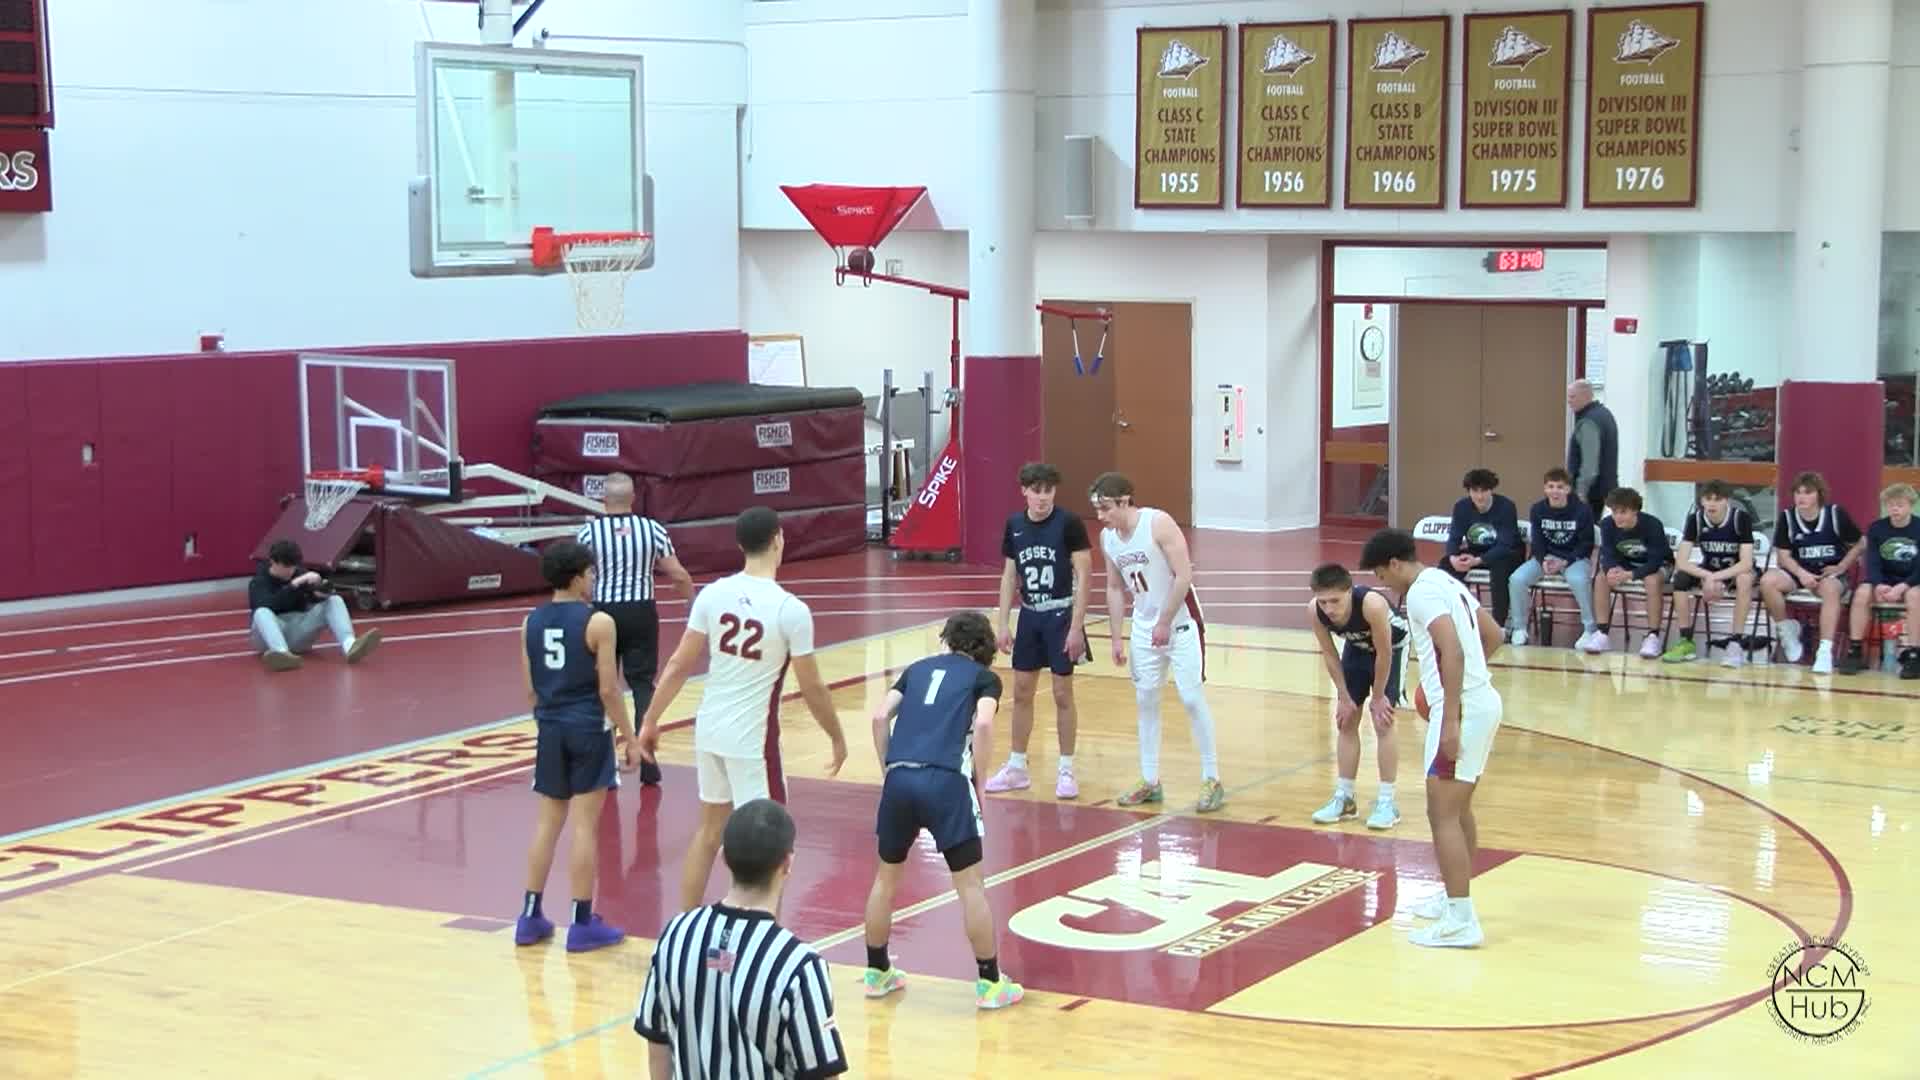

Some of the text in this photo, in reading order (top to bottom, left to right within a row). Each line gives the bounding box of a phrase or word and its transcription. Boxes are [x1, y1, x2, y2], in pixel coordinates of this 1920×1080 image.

[1376, 82, 1416, 93] FOOTBALL
[1494, 79, 1536, 89] FOOTBALL
[1620, 73, 1664, 86] FOOTBALL
[1163, 87, 1198, 98] FOOTBALL
[1266, 84, 1304, 96] FOOTBALL
[1261, 104, 1310, 120] CLASS C
[1369, 103, 1422, 119] CLASS B
[1474, 100, 1557, 116] DIVISION III
[1598, 95, 1686, 113] DIVISION III
[1158, 107, 1204, 123] CLASS C
[1164, 127, 1196, 143] STATE
[1267, 125, 1302, 142] STATE
[1378, 124, 1414, 140] STATE
[1472, 121, 1558, 138] SUPER BOWL
[1597, 117, 1686, 136] SUPER BOWL
[1145, 148, 1216, 164] CHAMPIONS
[1247, 146, 1322, 162] CHAMPIONS
[1356, 145, 1435, 161] CHAMPIONS
[1472, 142, 1557, 160] CHAMPIONS
[1596, 138, 1687, 158] CHAMPIONS
[1160, 173, 1199, 192] 1955
[1264, 171, 1304, 192] 1956
[1373, 170, 1415, 192] 1966
[1491, 168, 1536, 192] 1975
[1616, 167, 1664, 190] 1976
[758, 423, 790, 440] FISHER
[586, 435, 617, 449] FISHER
[755, 471, 788, 487] FISHER
[918, 455, 958, 509] SPIKE
[1019, 546, 1057, 564] ESSEX
[1025, 565, 1054, 590] 24
[1130, 571, 1149, 593] 11
[719, 612, 764, 661] 22
[544, 628, 566, 669] 5
[924, 669, 947, 705] 1
[1169, 924, 1246, 955] CAPE
